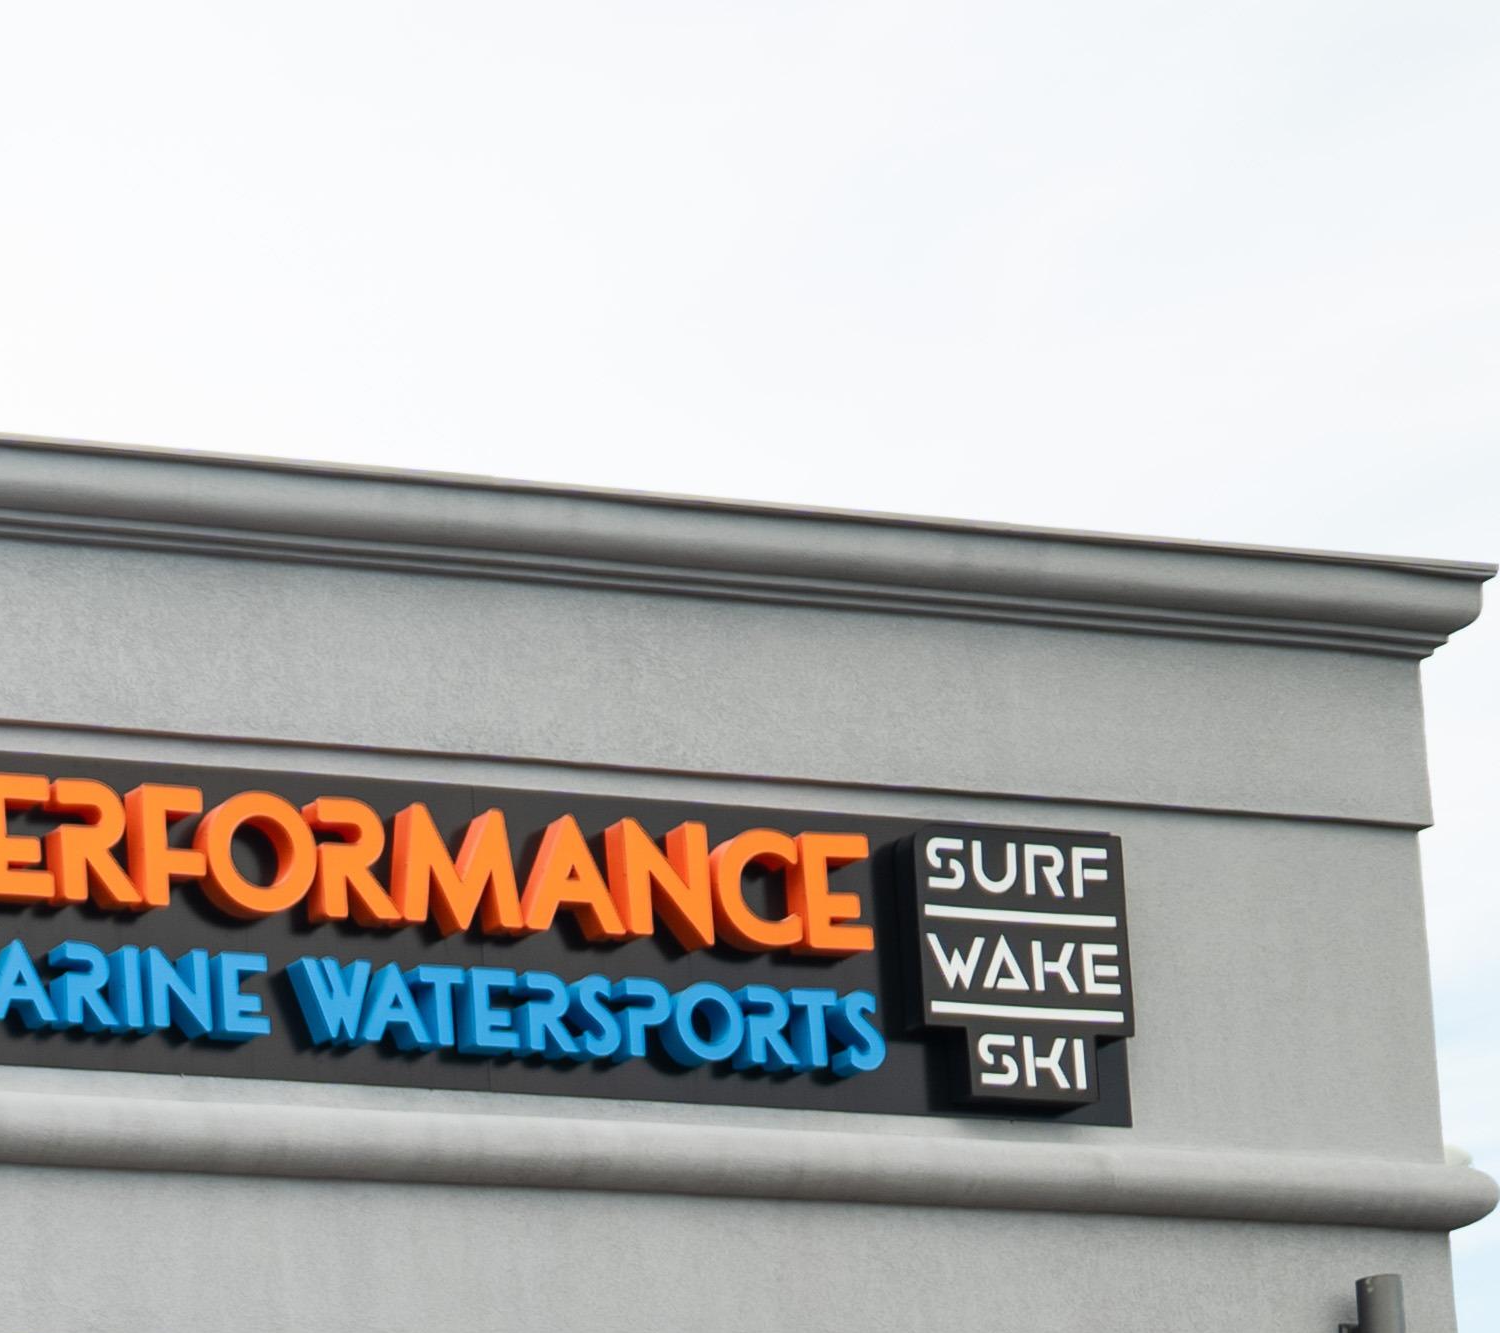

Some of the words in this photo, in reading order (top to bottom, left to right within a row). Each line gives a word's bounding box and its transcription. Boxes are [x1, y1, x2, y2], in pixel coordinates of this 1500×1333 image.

[926, 837, 1108, 898] SURF
[926, 933, 1122, 995] WAKE
[286, 956, 887, 1078] WATERSPORTS
[978, 1033, 1088, 1091] SKI
